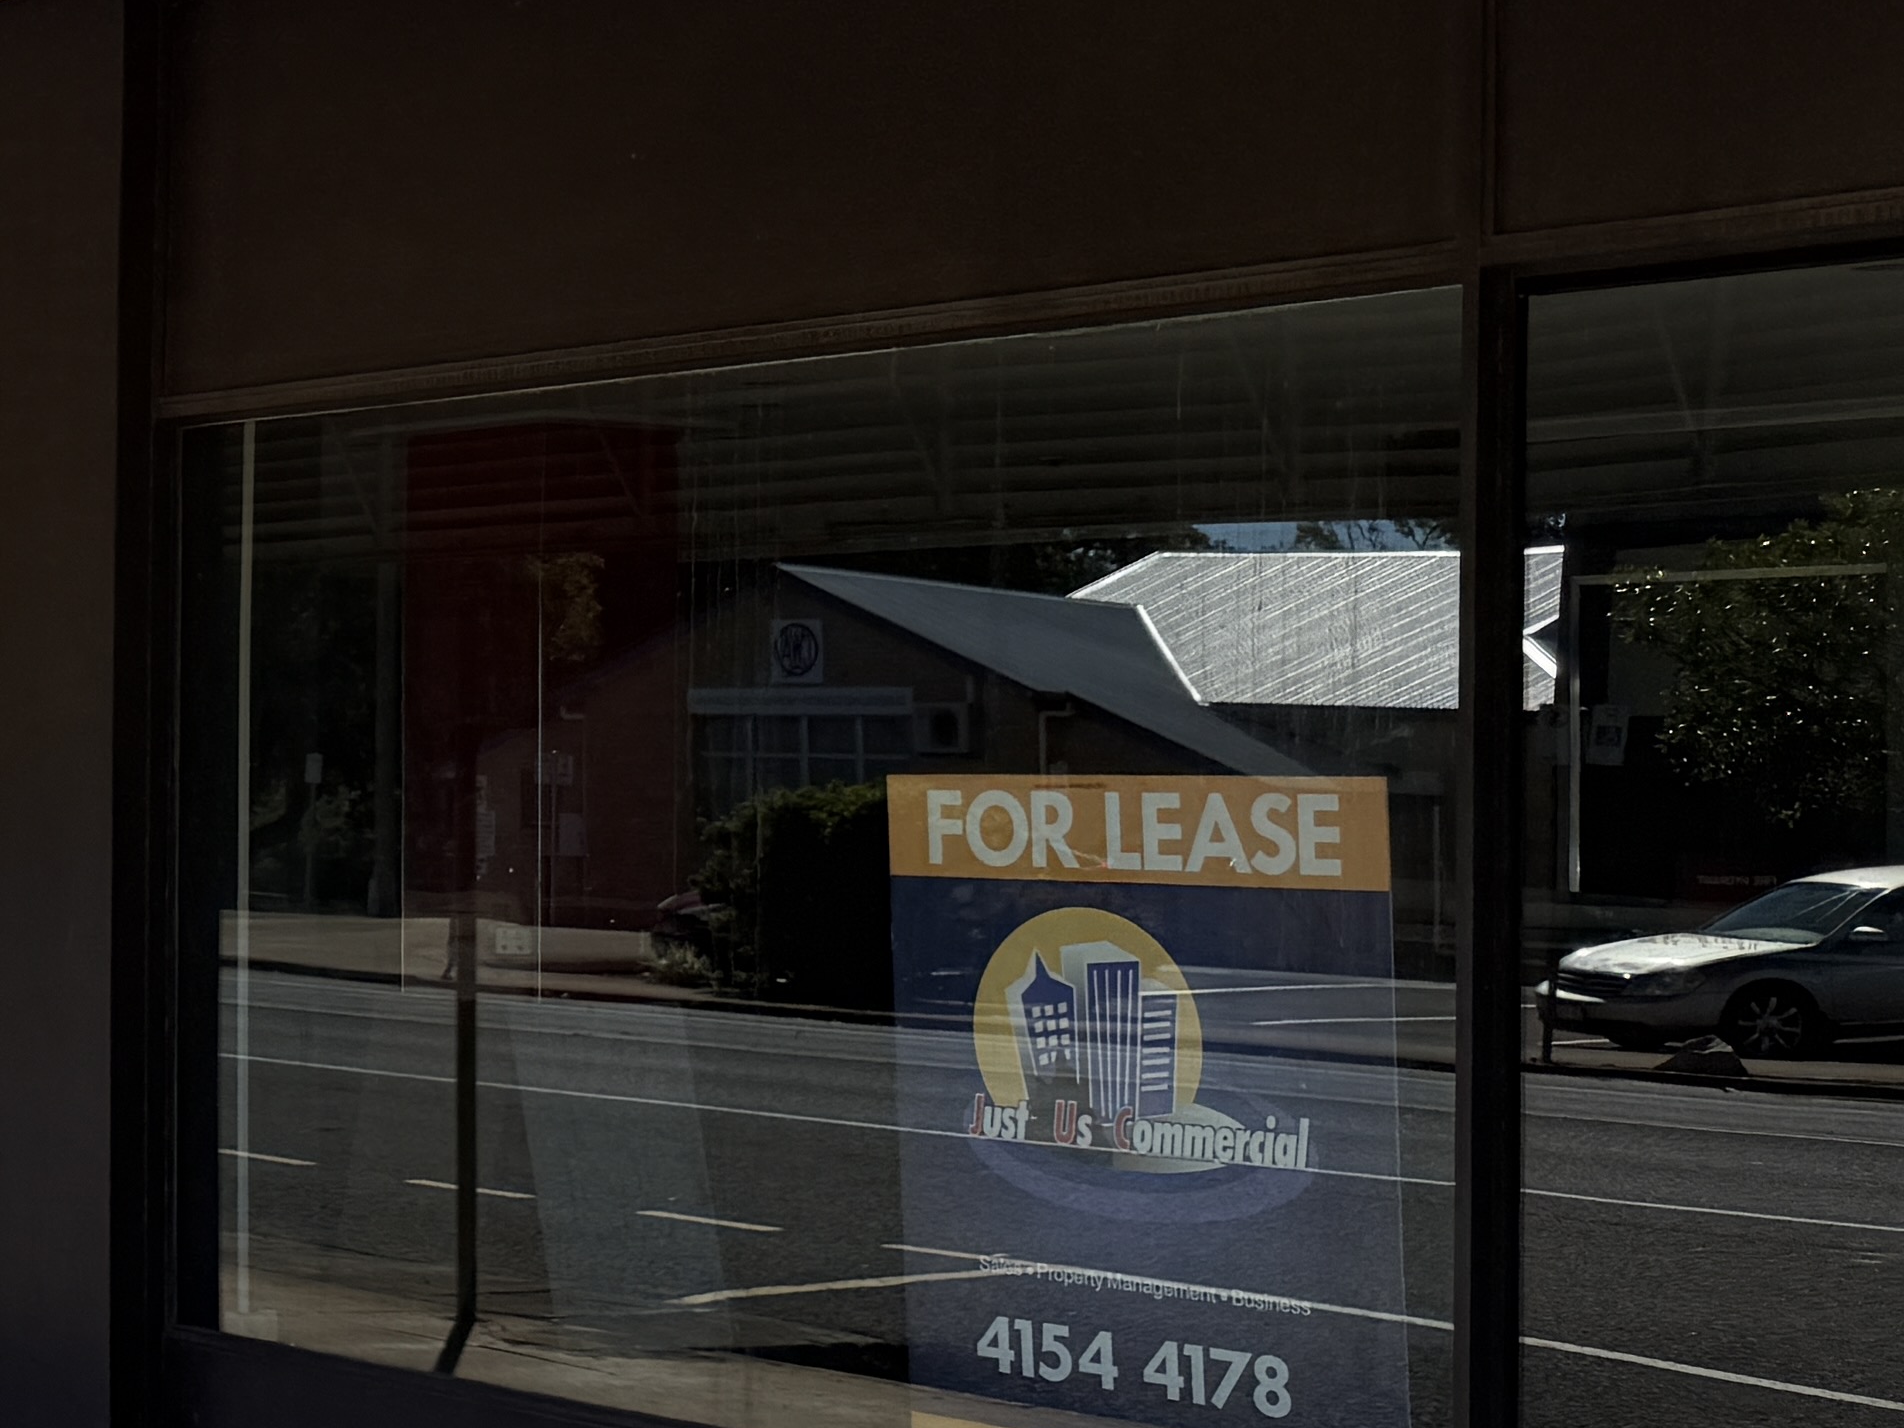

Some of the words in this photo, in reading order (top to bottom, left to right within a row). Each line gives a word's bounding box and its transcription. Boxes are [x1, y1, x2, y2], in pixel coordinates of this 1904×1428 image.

[926, 789, 1080, 869] FOR
[1104, 791, 1343, 876] LEASE
[969, 1092, 1030, 1141] Just
[1053, 1099, 1093, 1147] Us
[1113, 1105, 1310, 1169] Commercial
[978, 1256, 1023, 1276] Sales
[1036, 1263, 1103, 1292] Property
[1107, 1272, 1217, 1304] Management
[1231, 1288, 1312, 1317] Business
[976, 1315, 1119, 1391] 4154
[1143, 1340, 1292, 1419] 4178
